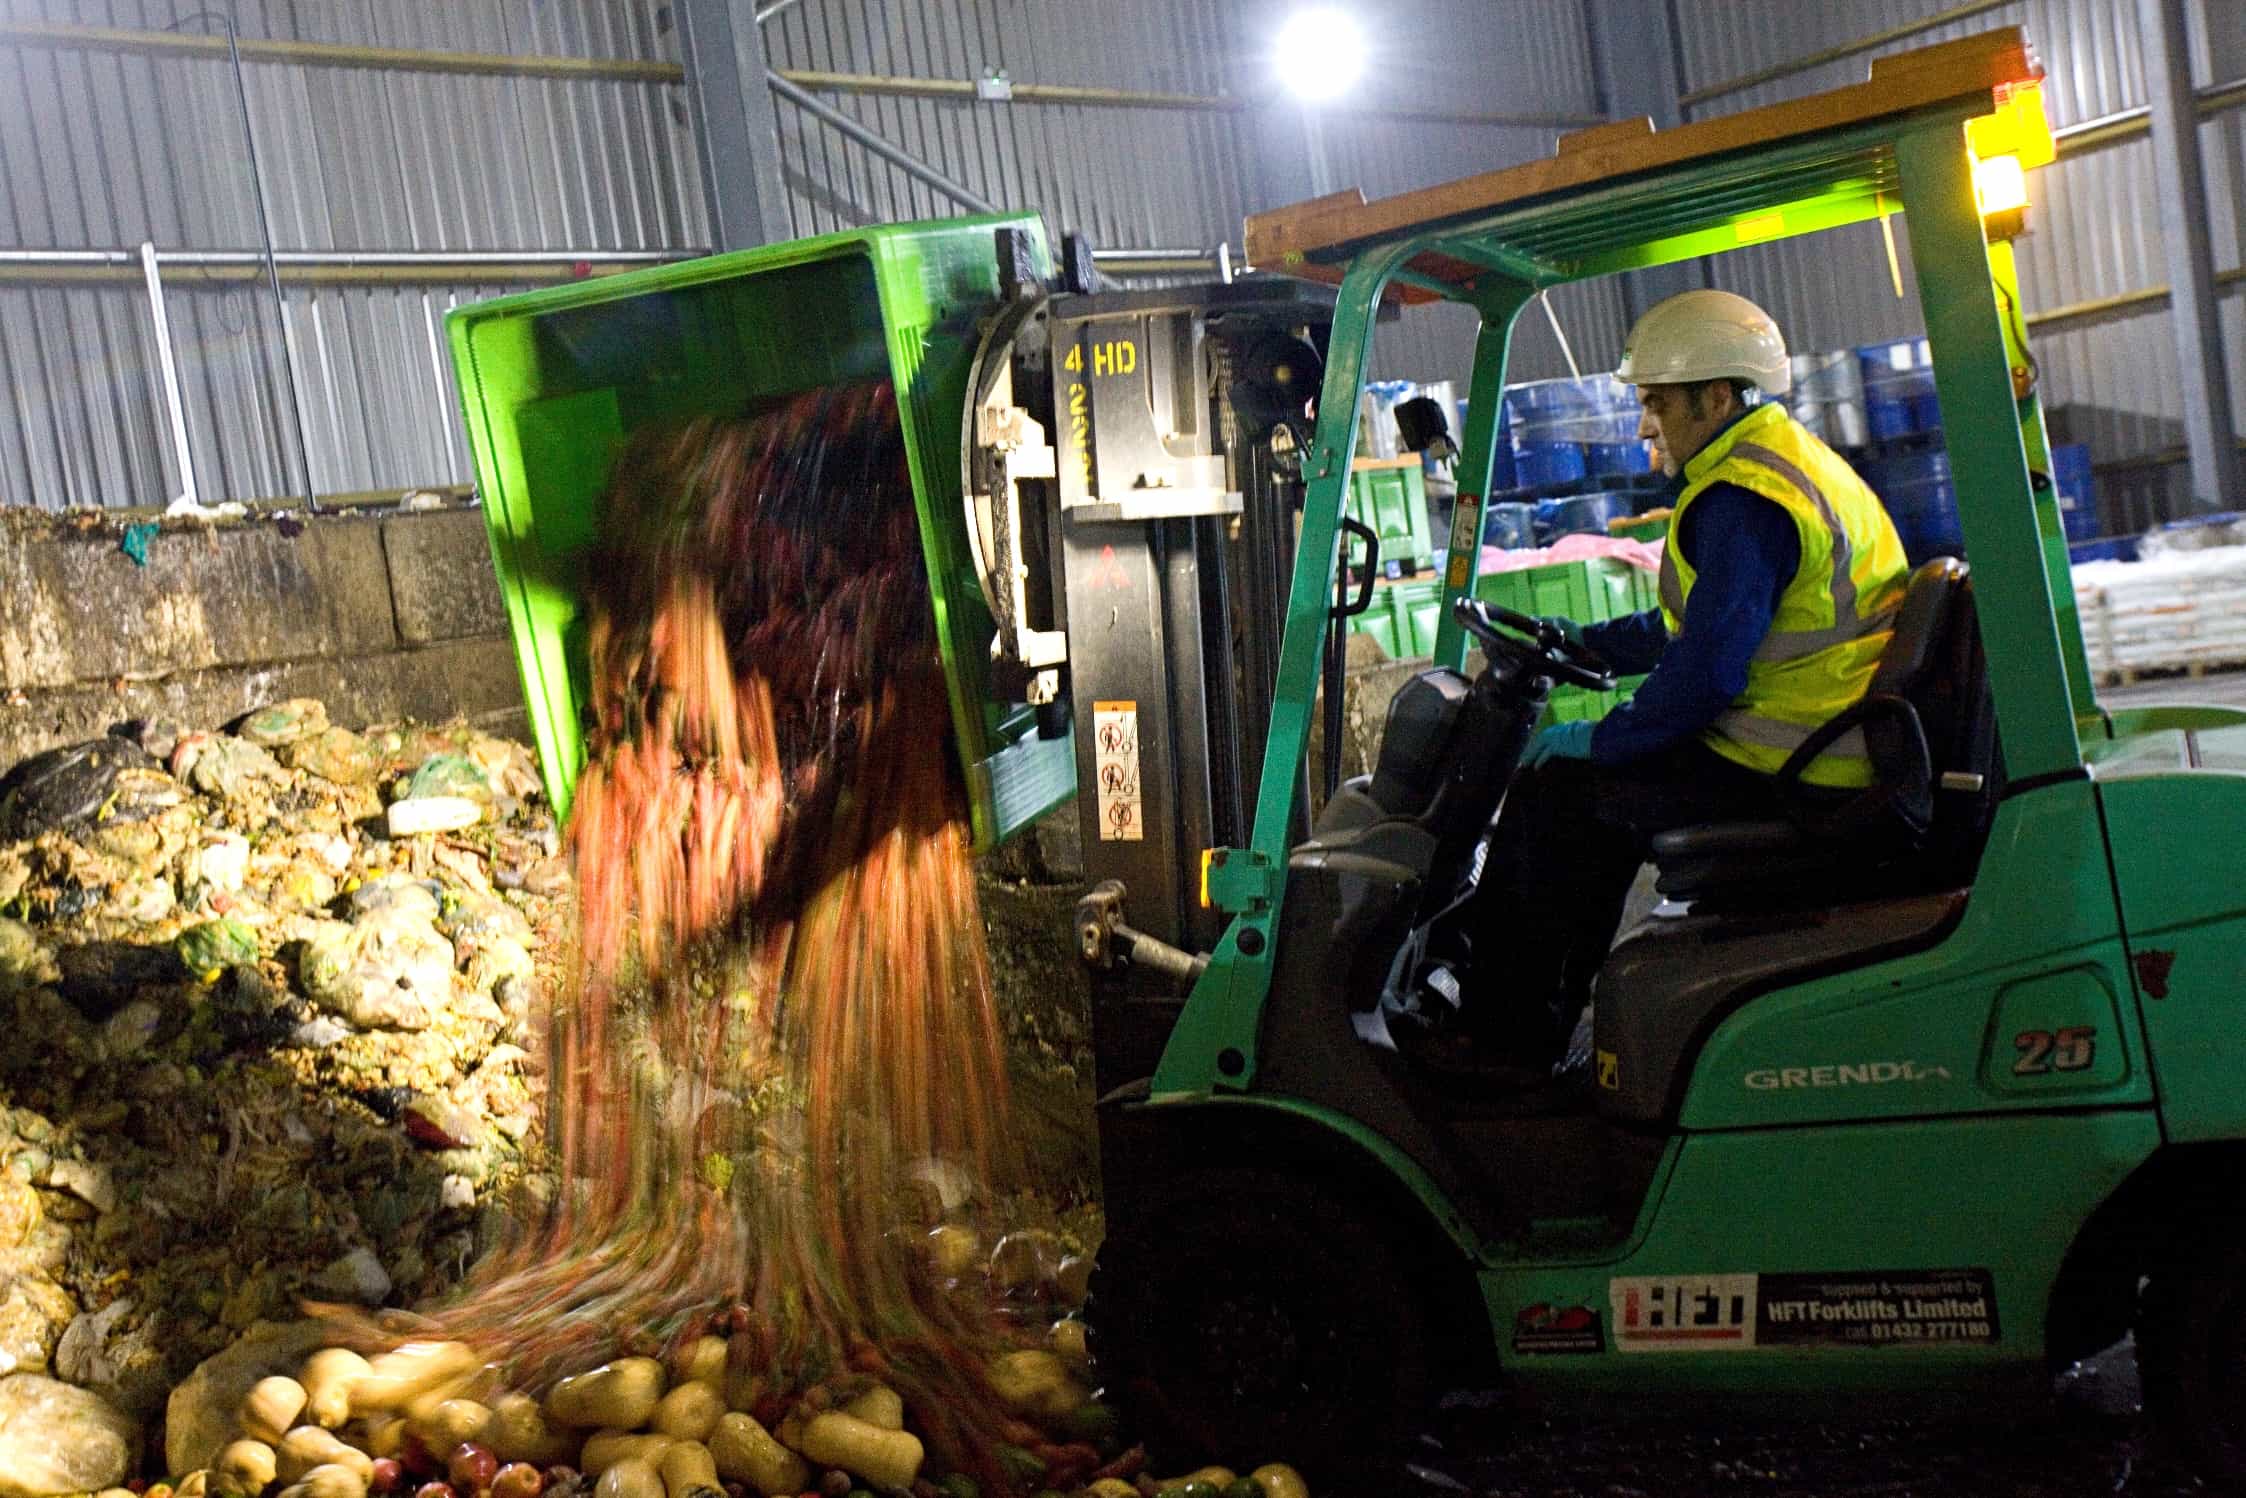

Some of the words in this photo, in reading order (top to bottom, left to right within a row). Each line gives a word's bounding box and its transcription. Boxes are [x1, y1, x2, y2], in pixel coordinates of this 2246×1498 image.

[1094, 340, 1136, 377] HD
[2013, 1025, 2098, 1077] 25
[1766, 1300, 1807, 1323] HFT
[1808, 1298, 1899, 1321] Forklifts
[1902, 1296, 1988, 1320] Limited
[1872, 1322, 1922, 1338] 01432
